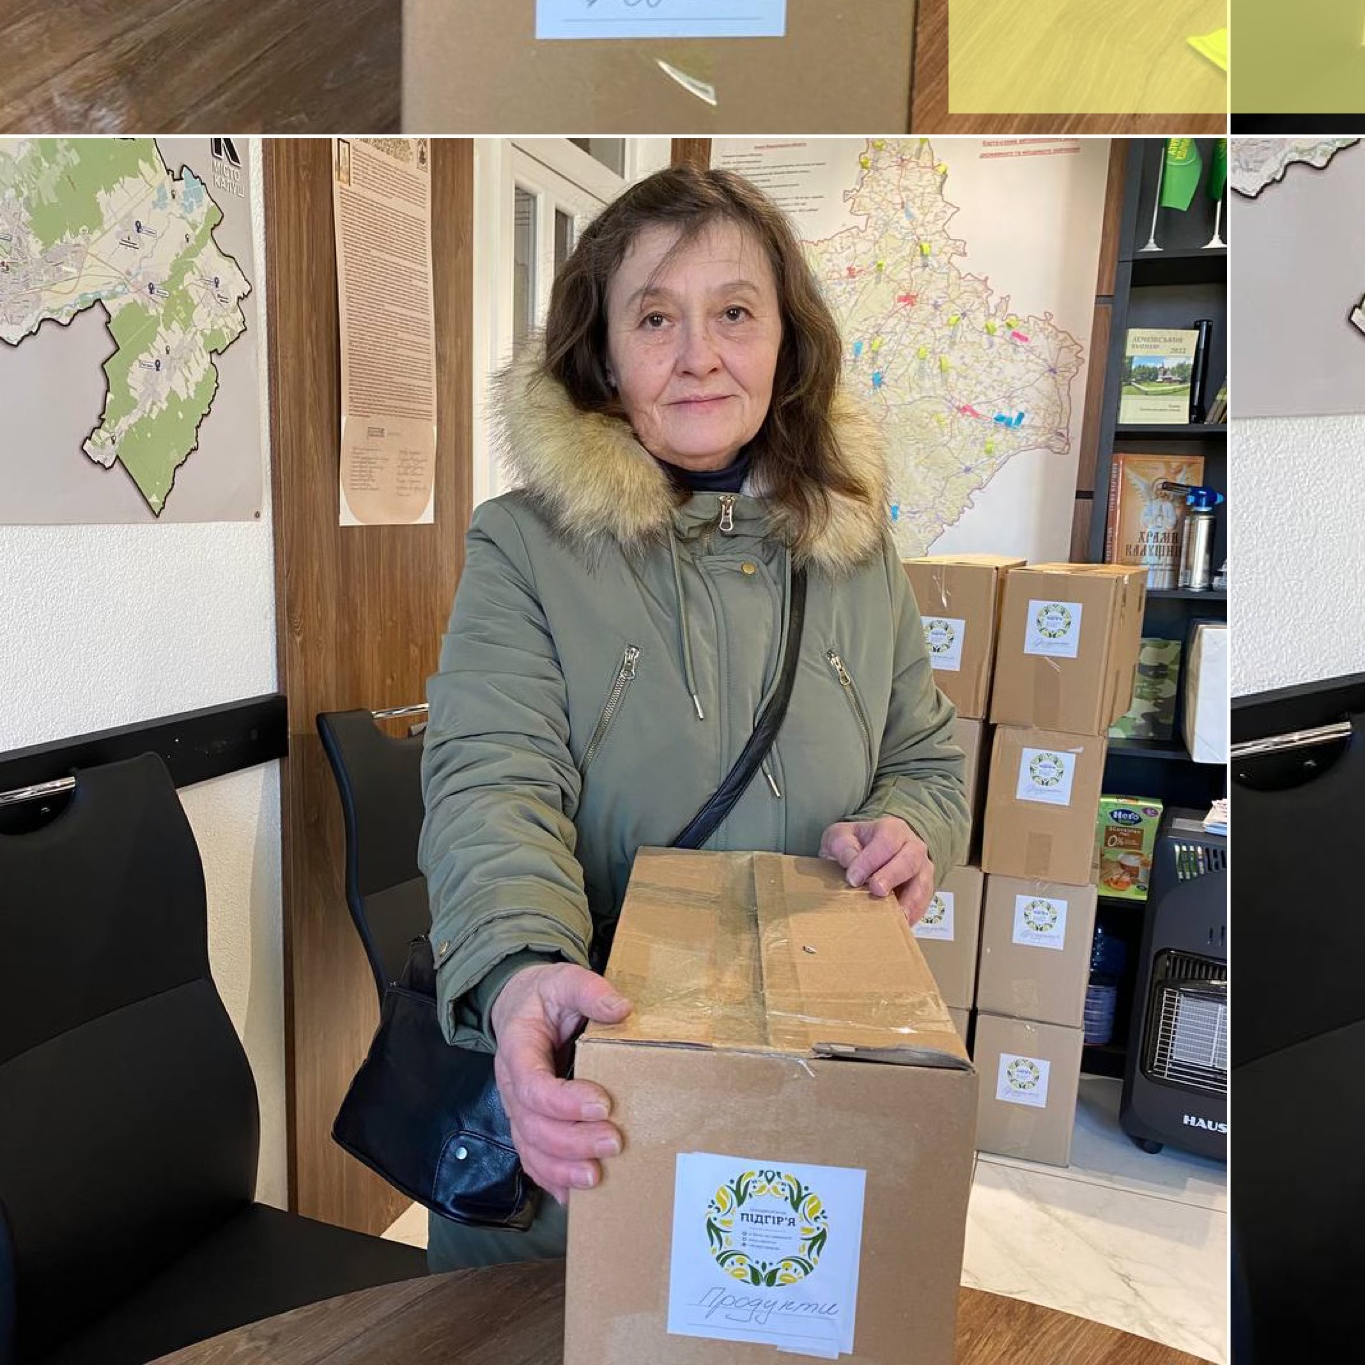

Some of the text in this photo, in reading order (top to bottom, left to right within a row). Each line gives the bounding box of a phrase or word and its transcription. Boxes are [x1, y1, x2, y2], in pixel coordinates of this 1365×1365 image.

[1112, 809, 1140, 820] Hero
[740, 1210, 797, 1230] ПІДГІР'Я
[701, 1285, 841, 1325] Продукти
